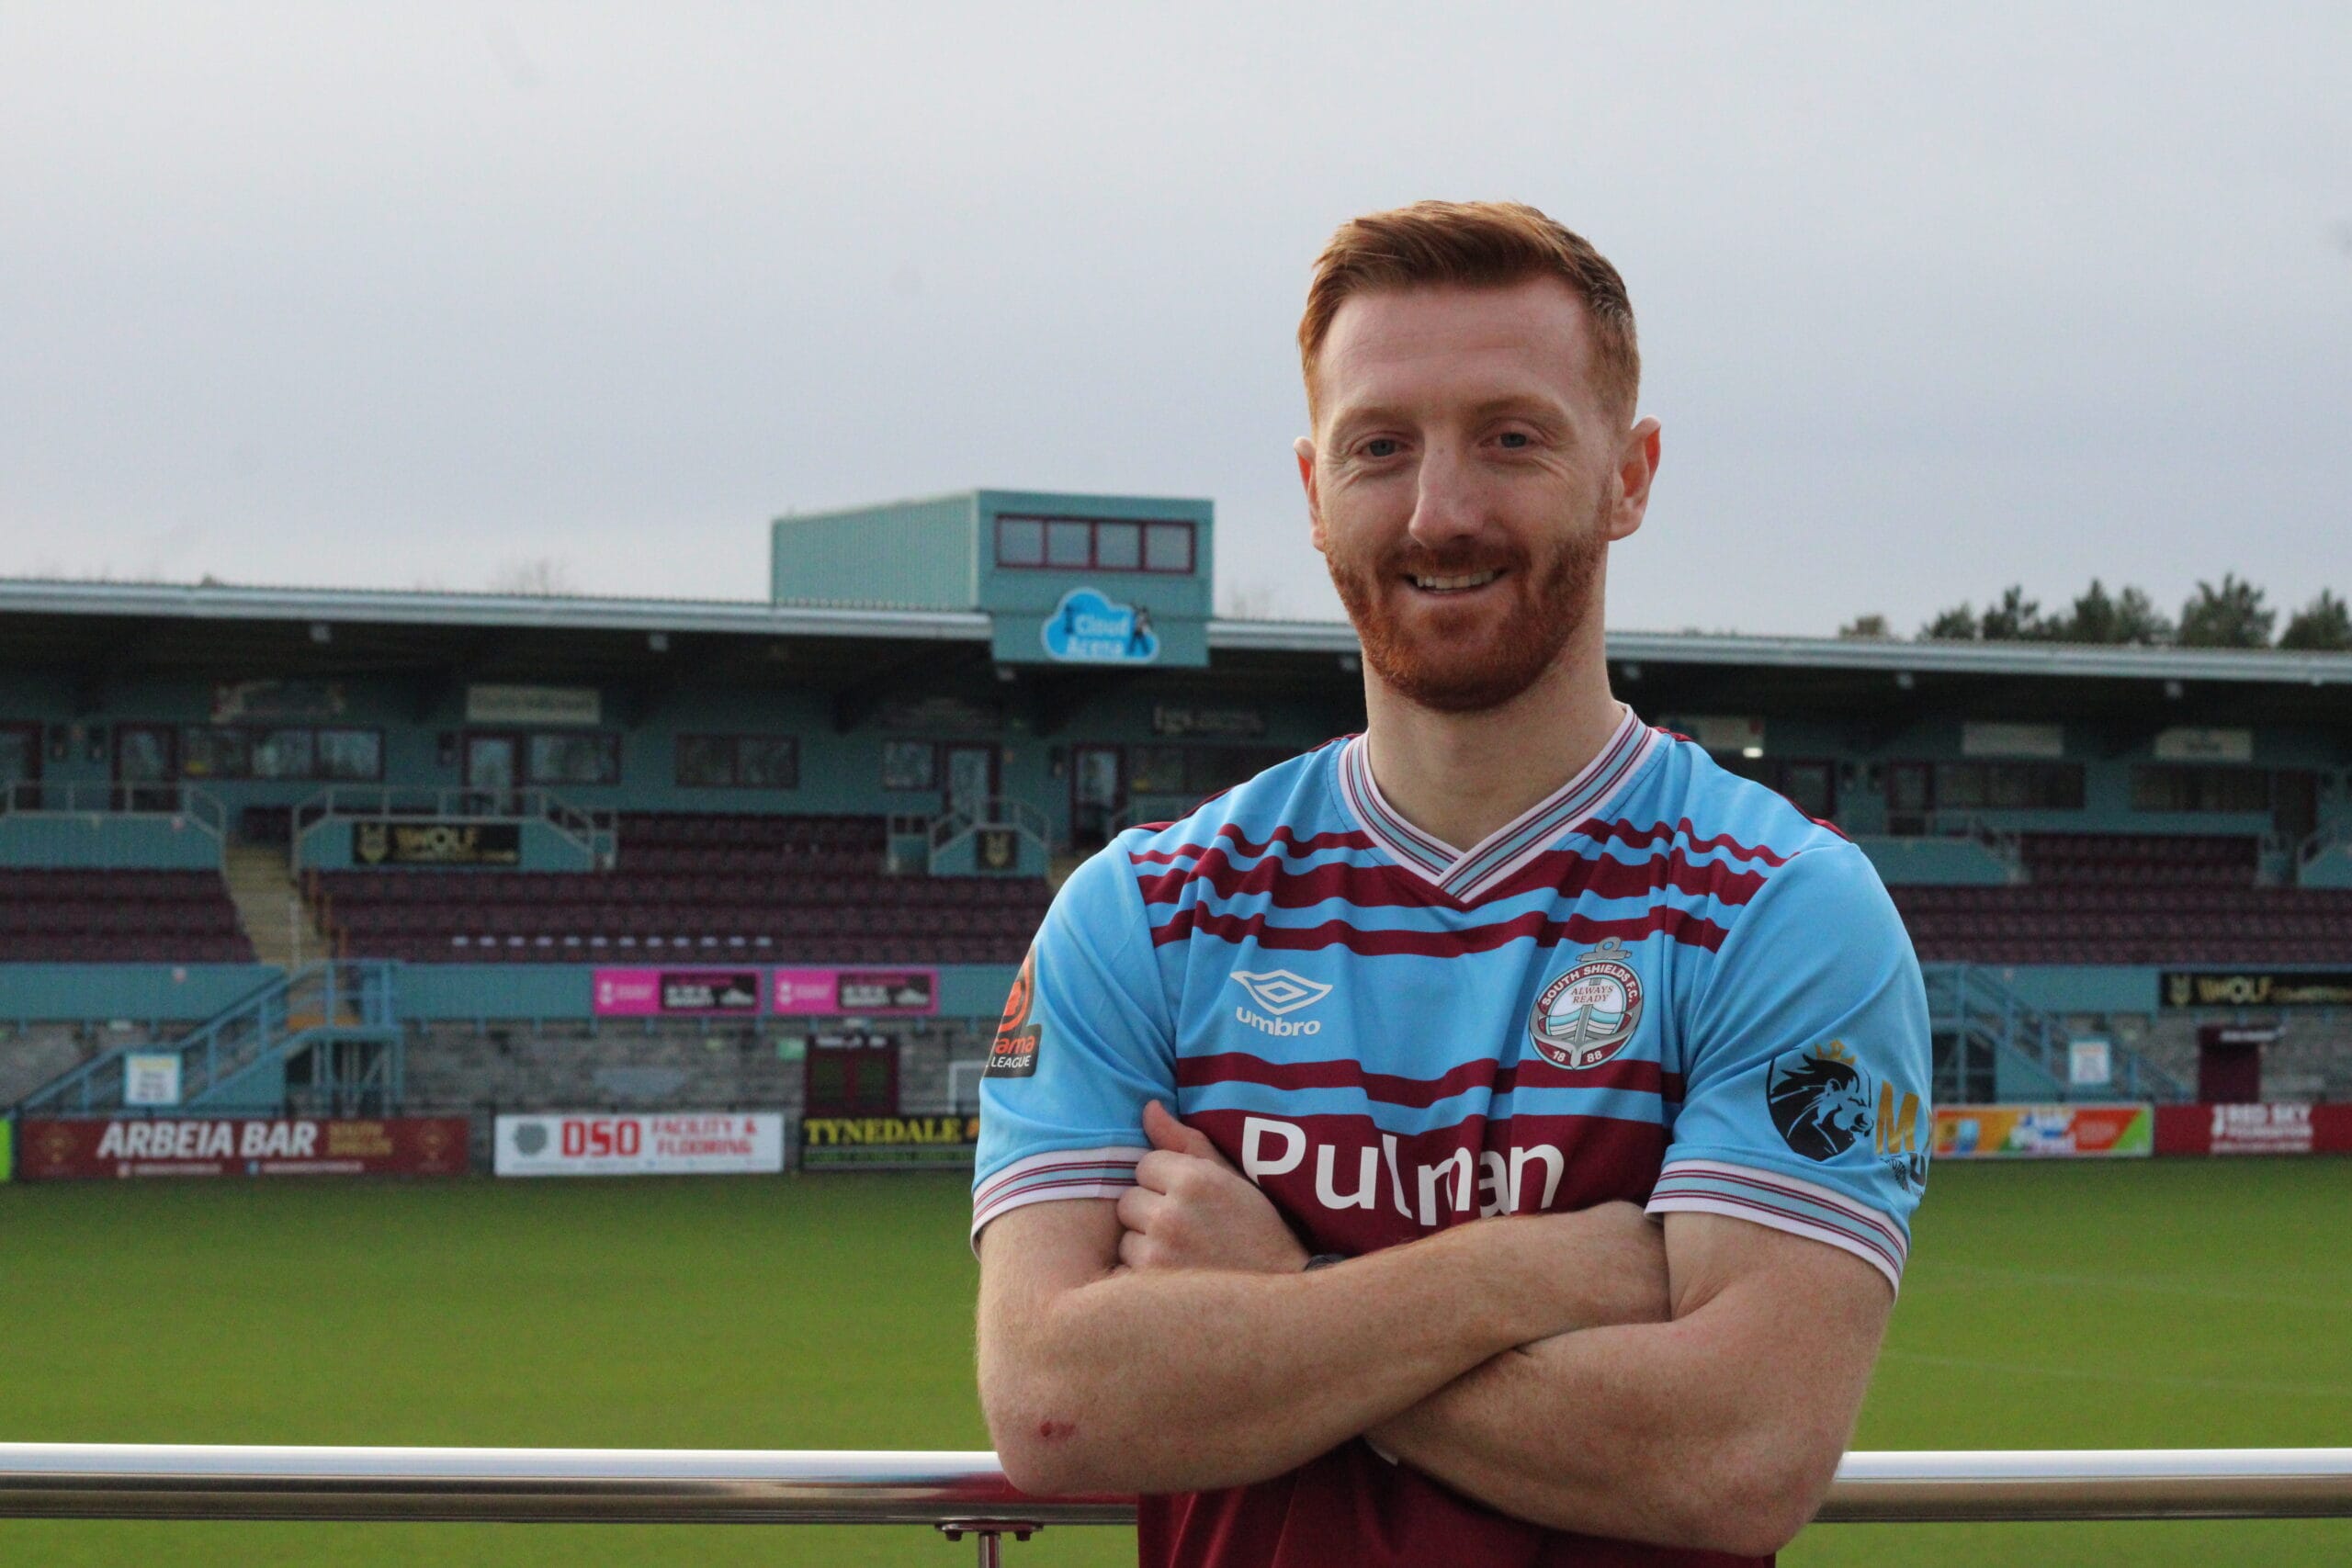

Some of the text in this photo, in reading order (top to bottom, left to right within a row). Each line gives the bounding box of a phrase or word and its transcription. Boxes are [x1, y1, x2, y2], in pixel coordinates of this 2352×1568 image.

[1542, 970, 1580, 1006] SOUTH
[1583, 964, 1630, 982] SHIELDS
[1571, 984, 1614, 996] ALWAYS
[1572, 993, 1609, 1004] READY
[1236, 1006, 1321, 1037] umbro
[990, 1055, 1032, 1068] LEAGUE
[1552, 1050, 1602, 1063] 18 88
[96, 1121, 318, 1158] ARBEIA BAR
[560, 1119, 641, 1158] DSO
[803, 1117, 962, 1146] TYNEDALE
[1241, 1115, 1565, 1226] Pulman
